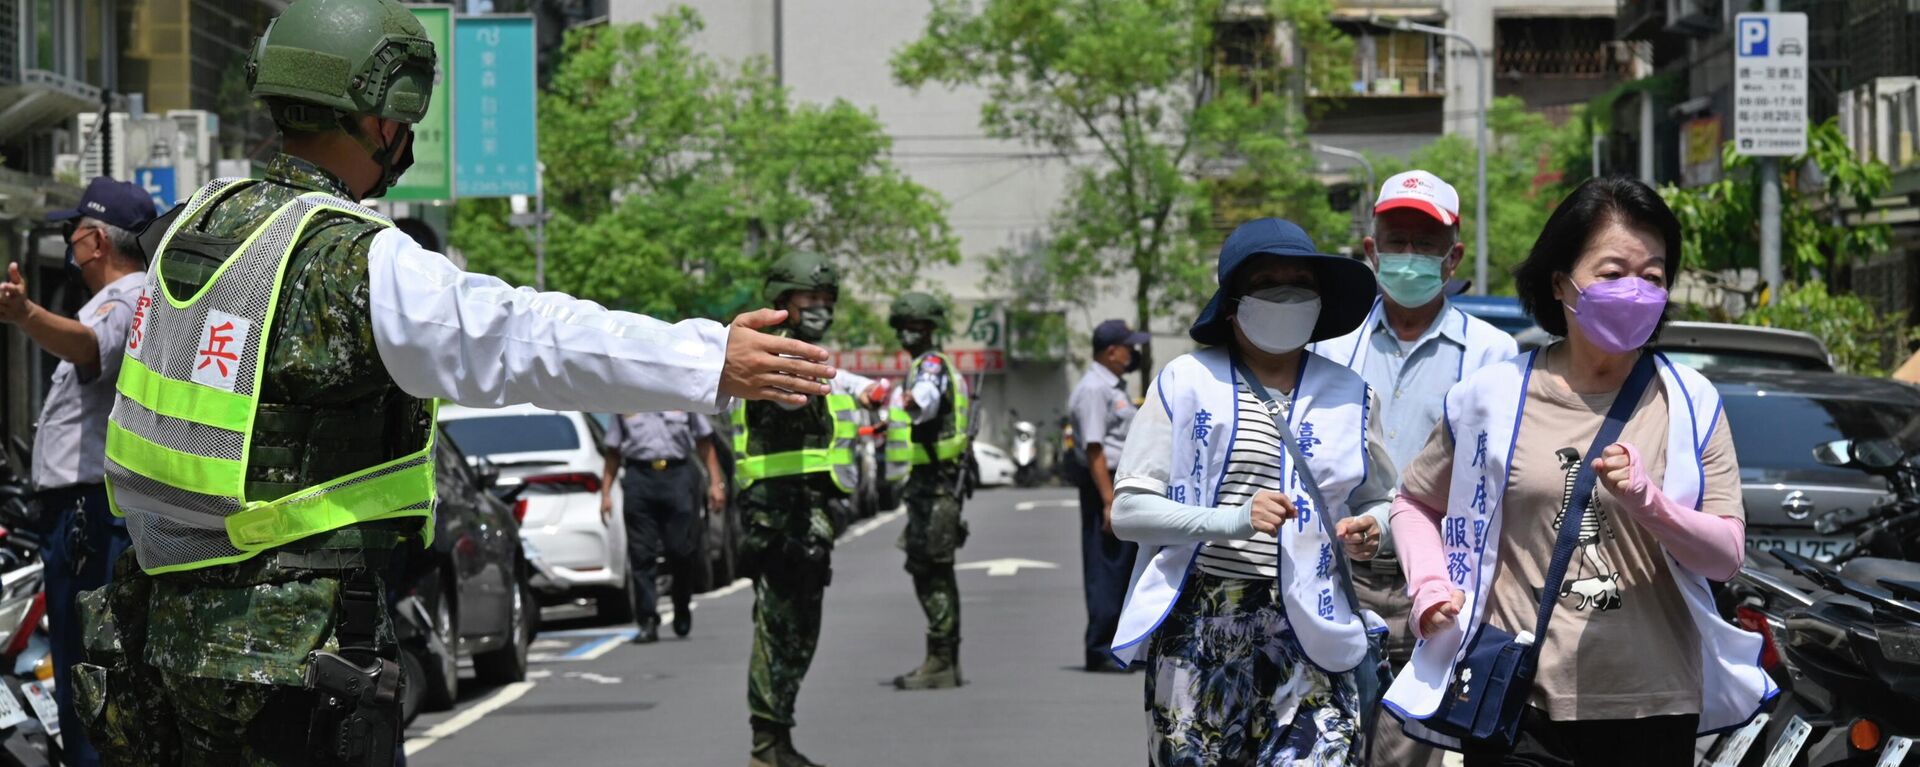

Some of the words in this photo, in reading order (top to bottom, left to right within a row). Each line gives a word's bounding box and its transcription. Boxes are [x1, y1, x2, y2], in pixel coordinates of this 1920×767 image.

[1742, 21, 1766, 54] P
[197, 320, 239, 378] 兵
[1443, 516, 1472, 586] 服務
